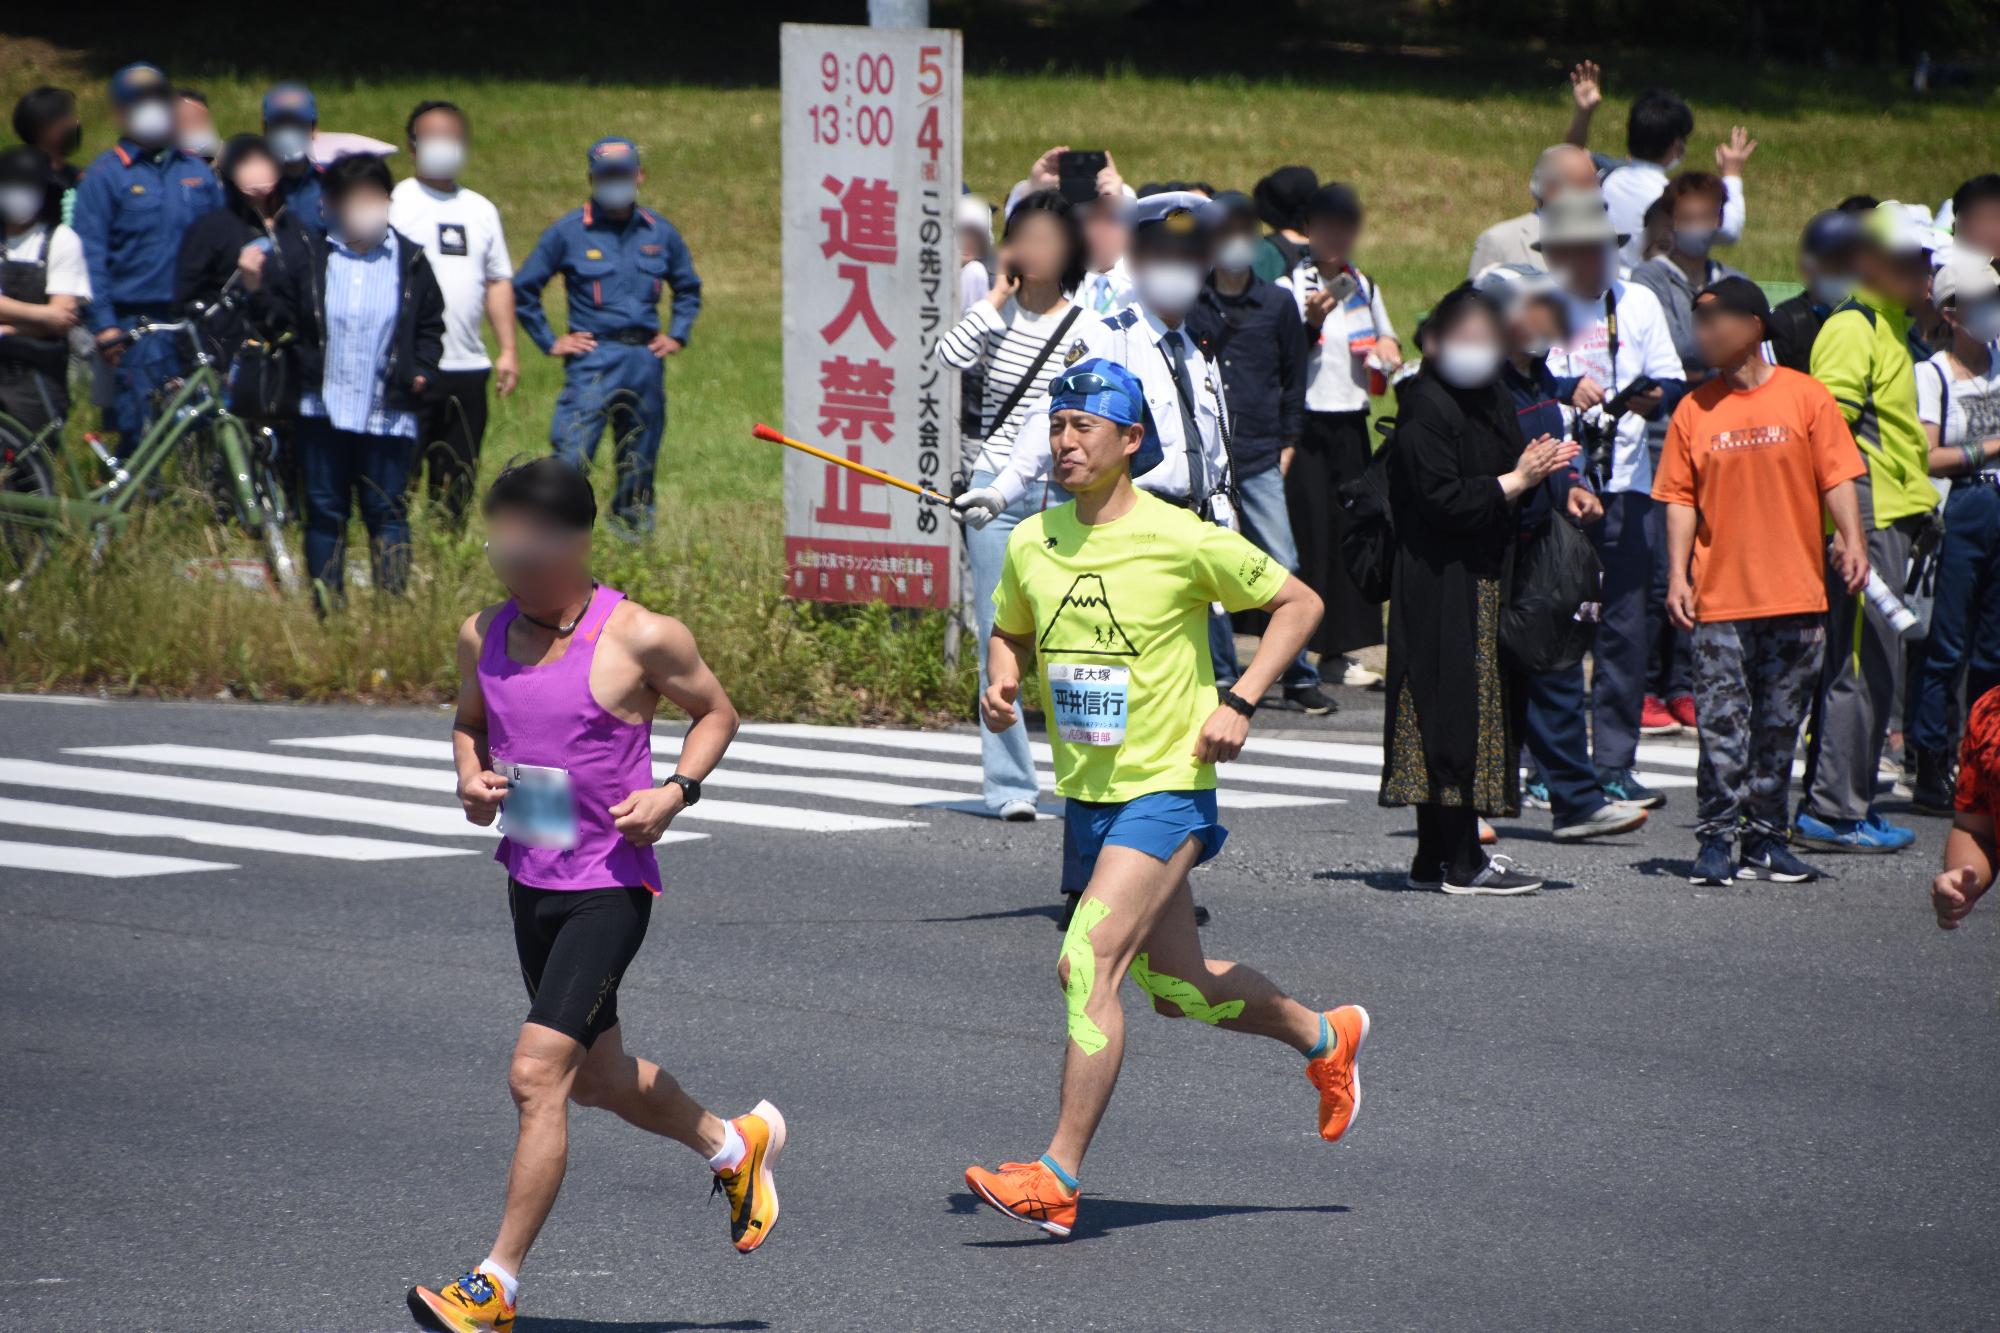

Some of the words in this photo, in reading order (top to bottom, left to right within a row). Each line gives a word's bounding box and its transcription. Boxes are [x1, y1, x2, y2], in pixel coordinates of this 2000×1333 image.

[821, 51, 894, 95] 9:00
[808, 104, 893, 146] 13:00
[815, 174, 899, 530] 進入禁止
[1073, 668, 1111, 681] 匠大塚
[1055, 688, 1124, 716] 平井信行
